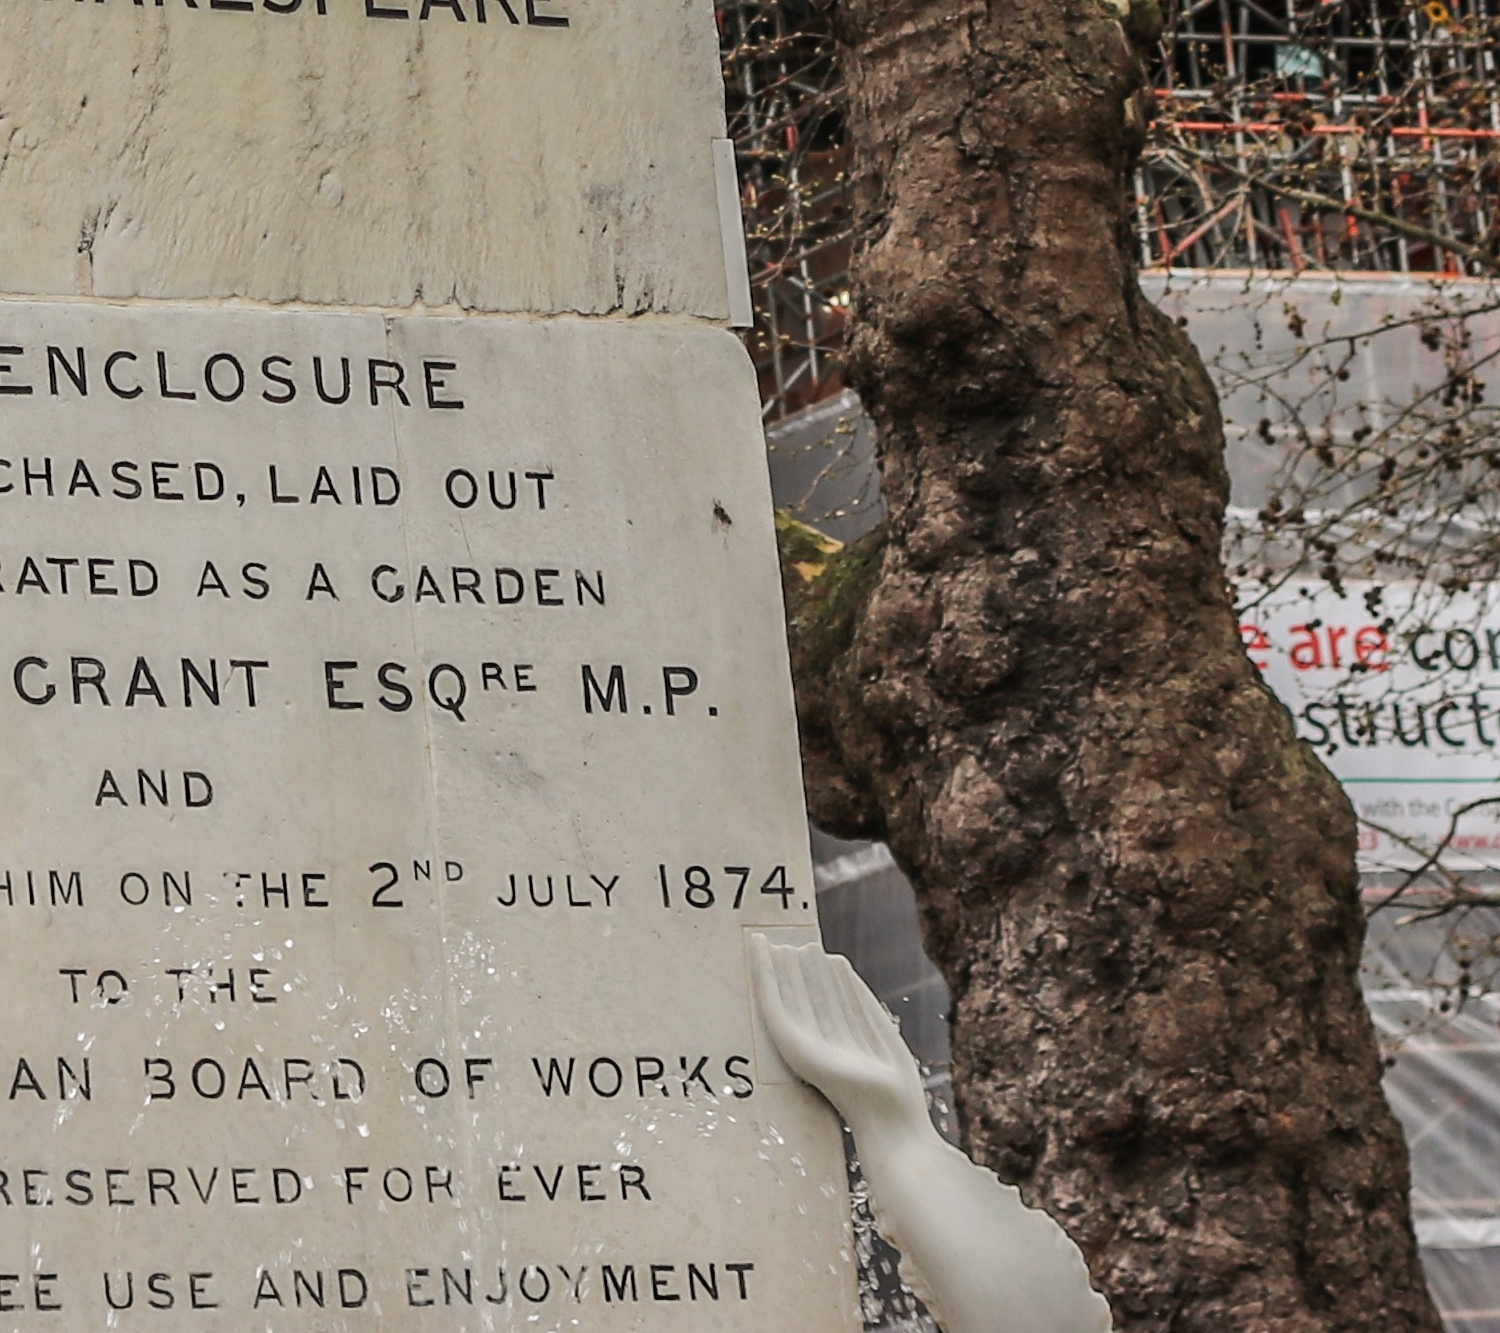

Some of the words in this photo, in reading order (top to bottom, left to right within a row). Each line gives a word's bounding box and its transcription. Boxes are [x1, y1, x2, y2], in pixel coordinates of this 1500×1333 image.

[269, 464, 401, 506] LAID
[445, 468, 555, 510] OUT
[197, 560, 270, 600] AS
[306, 562, 338, 601] A
[371, 564, 605, 606] GARDEN
[1238, 623, 1270, 670] e
[1289, 623, 1389, 671] are
[13, 656, 269, 708] GRANT
[581, 664, 718, 717] M.P.
[95, 768, 213, 808] AND
[120, 871, 192, 906] ON
[223, 872, 329, 909] THE
[497, 874, 619, 907] JULY
[659, 864, 810, 910] 1874.
[59, 969, 128, 1005] TO
[165, 968, 277, 1004] THE
[144, 1057, 365, 1100] BOARD
[414, 1057, 492, 1098] OF
[531, 1055, 754, 1099] WORKS
[344, 1166, 453, 1204] FOR
[498, 1164, 651, 1202] EVER
[103, 1272, 218, 1310] USE
[254, 1268, 368, 1309] AND
[407, 1263, 754, 1307] ENJOYMENT
